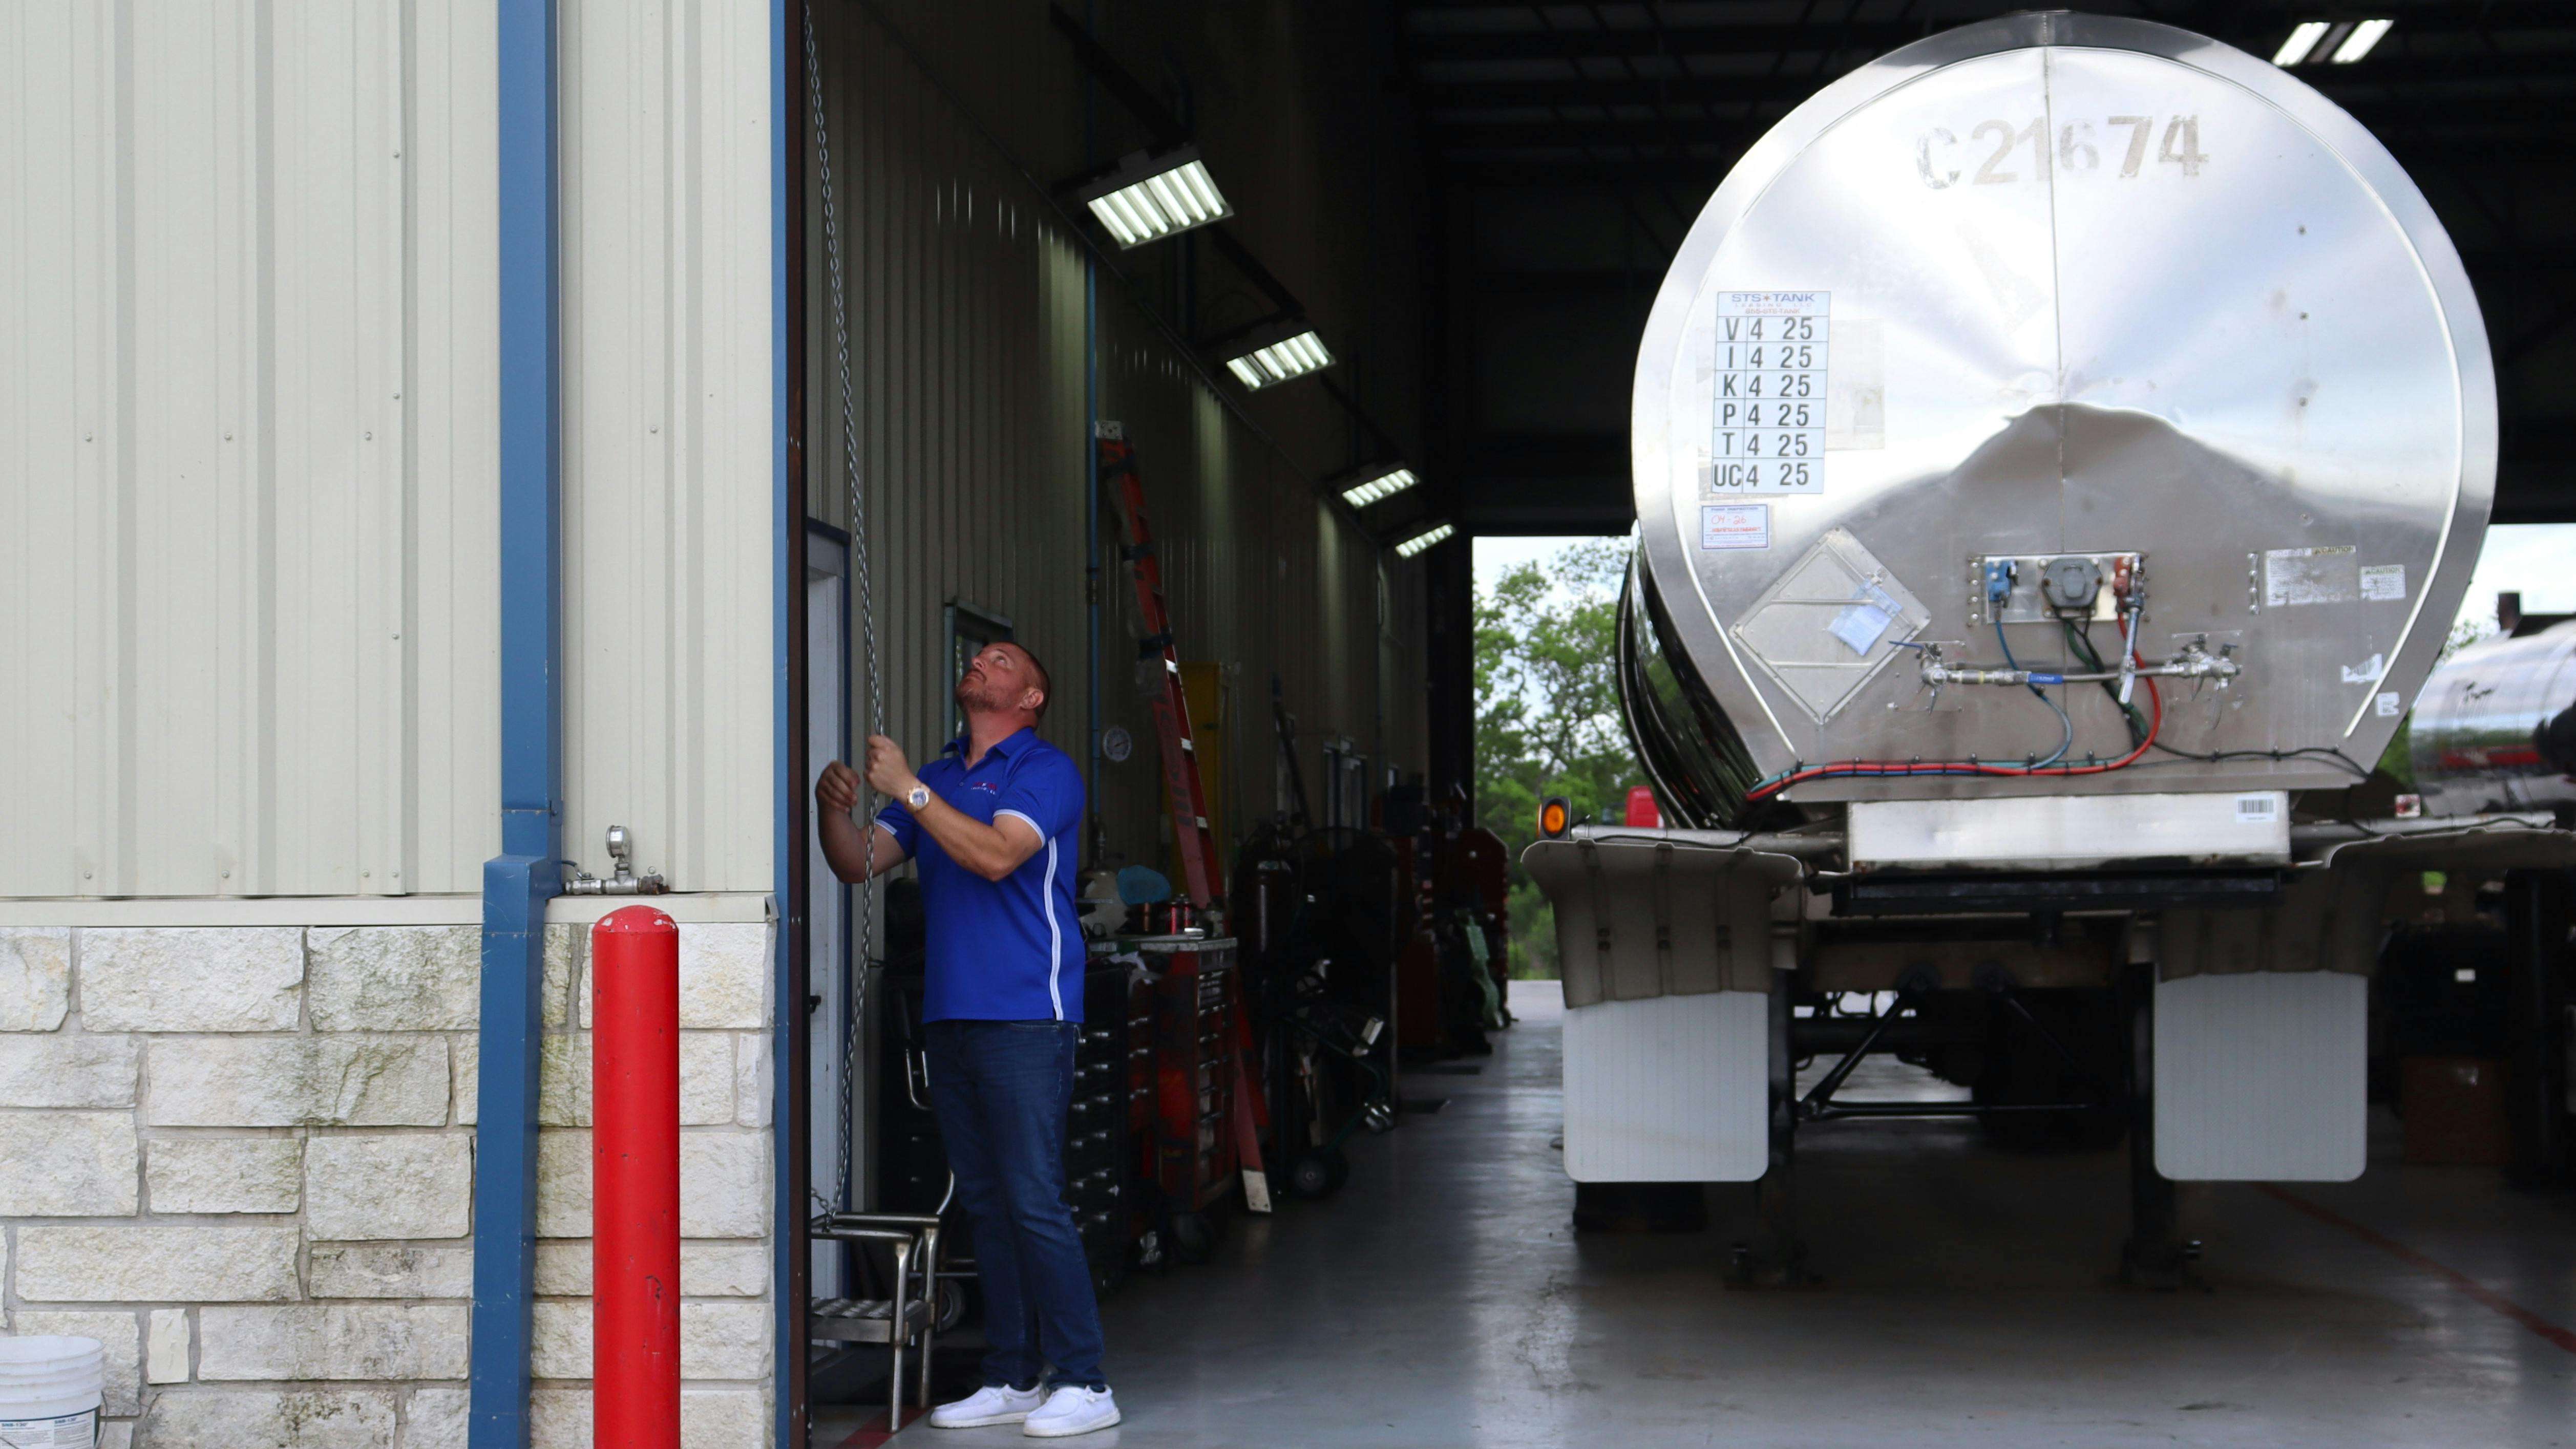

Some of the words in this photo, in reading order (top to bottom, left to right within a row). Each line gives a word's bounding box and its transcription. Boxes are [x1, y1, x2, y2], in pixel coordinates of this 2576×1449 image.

[1725, 318, 1740, 340] V
[1750, 318, 1763, 340] 4
[1783, 316, 1813, 340] 25
[1728, 346, 1734, 368] I
[1750, 346, 1763, 368] 4
[1780, 346, 1812, 368] 25
[1723, 374, 1738, 396] K
[1748, 375, 1762, 397] 4
[1780, 374, 1810, 397] 25
[1723, 403, 1736, 425] P
[1748, 403, 1761, 425] 4
[1778, 403, 1809, 427] 25
[1722, 432, 1735, 455] T
[1747, 434, 1760, 456] 4
[1778, 434, 1808, 456] 25
[1714, 464, 1742, 486] UC
[1746, 464, 1759, 487] 4
[1780, 463, 1809, 485] 25
